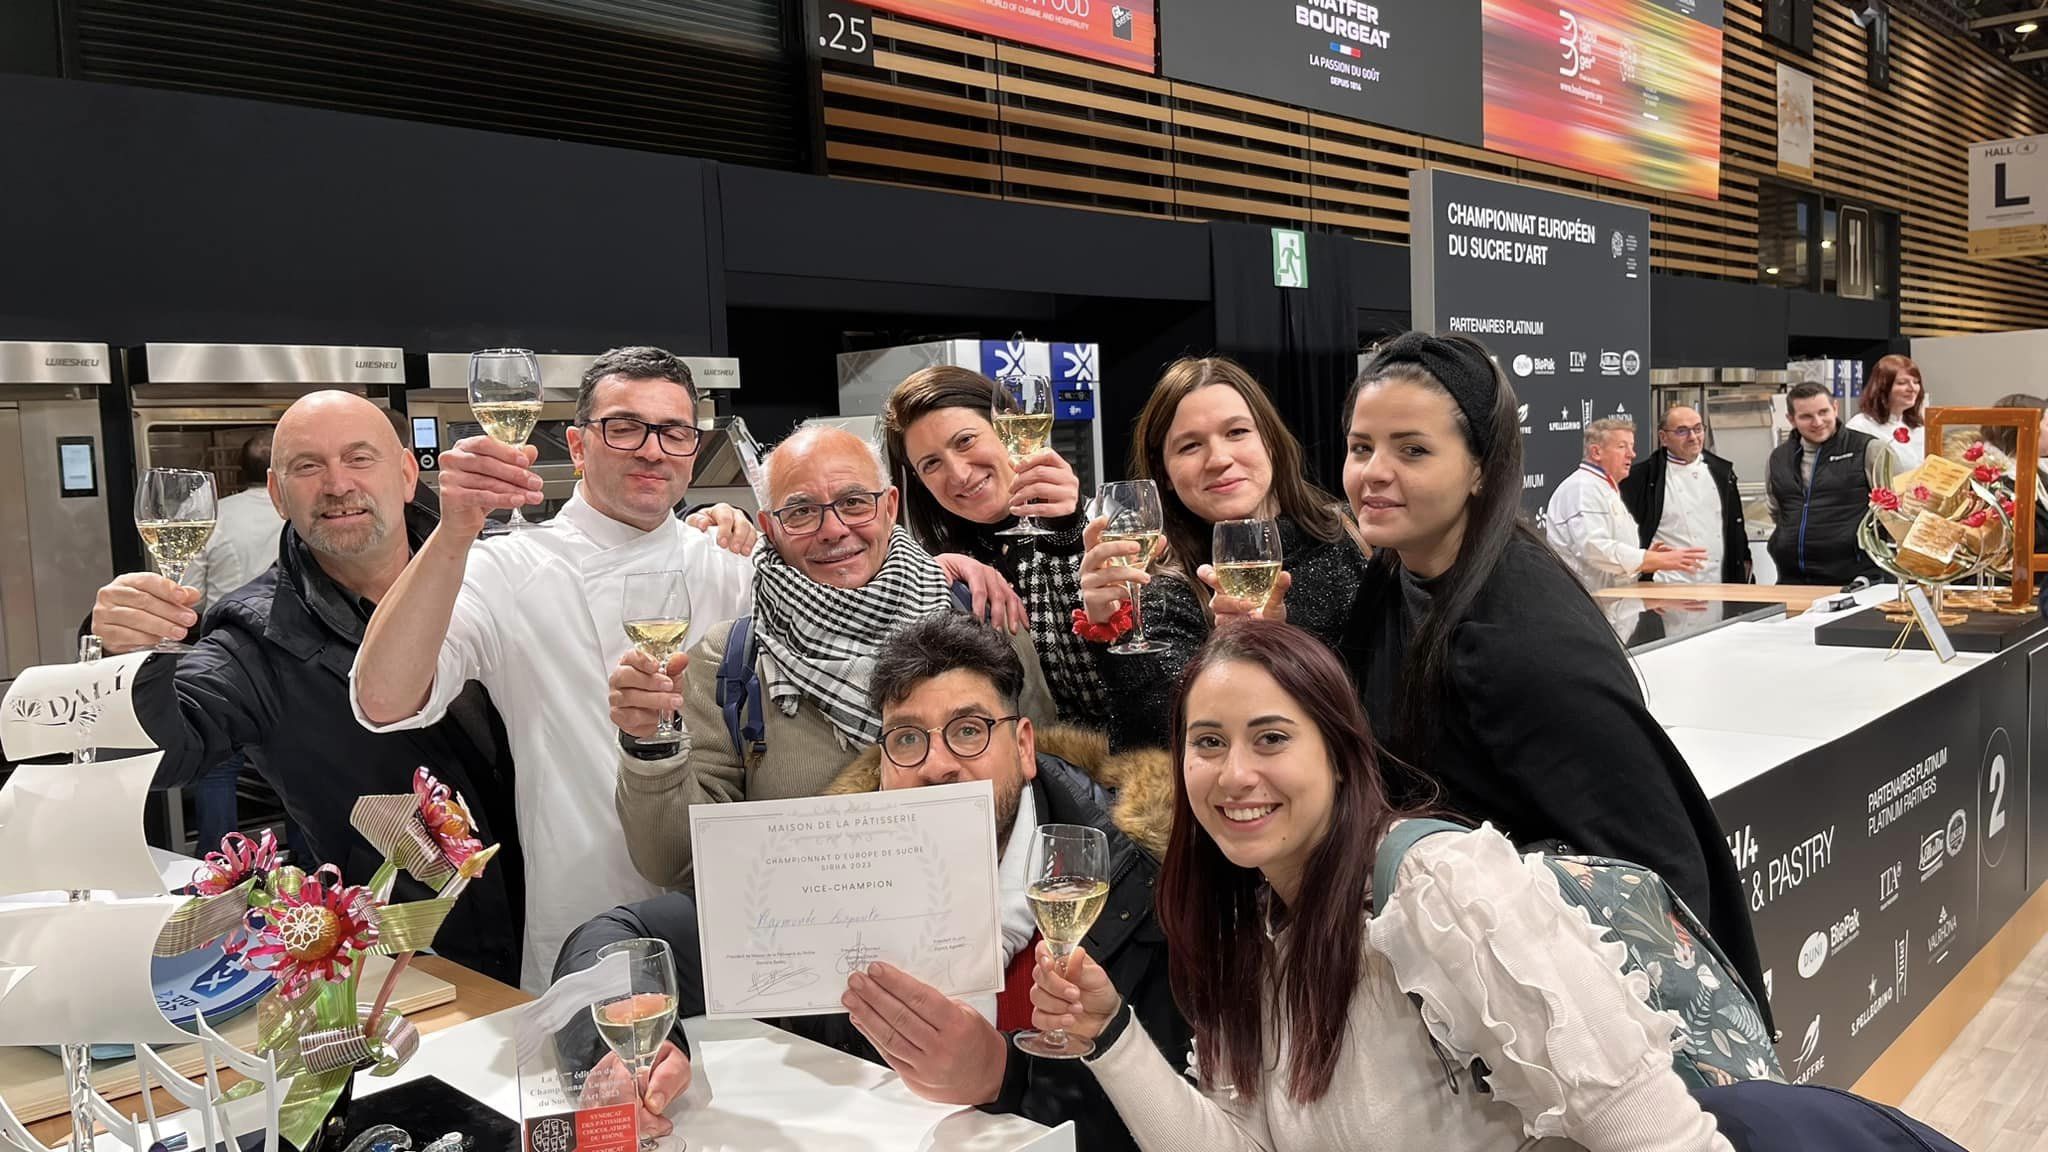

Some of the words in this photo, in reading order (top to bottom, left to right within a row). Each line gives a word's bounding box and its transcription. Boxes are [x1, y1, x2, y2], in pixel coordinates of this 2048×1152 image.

[1296, 5, 1390, 49] BOURGEAT
[1310, 54, 1319, 67] LA
[1320, 57, 1350, 75] PASSION
[1351, 65, 1361, 77] DU
[1362, 67, 1380, 82] GOÛT
[1330, 76, 1350, 88] DEPUIS
[1985, 146, 2013, 158] HALL
[1995, 163, 2030, 208] L
[1448, 202, 1536, 234] CHAMPIONNAT
[1538, 218, 1596, 244] EUROPÉEN
[1449, 234, 1467, 256] DU
[1470, 237, 1513, 262] SUCRE
[1515, 243, 1548, 266] D'ART
[1450, 317, 1505, 334] PARTENAIRES
[1506, 320, 1544, 335] PLATINUM
[45, 357, 99, 367] WIESHEU
[355, 360, 398, 369] WIESHEU
[1523, 473, 1544, 489] MIUM
[1868, 772, 1915, 813] PARTENAIRES
[1916, 746, 1948, 783] PLATINUM
[1868, 798, 1903, 837] PLATINUM
[1903, 775, 1937, 813] PARTNERS
[1988, 754, 2006, 839] 2
[768, 822, 813, 833] MAISON
[818, 820, 831, 830] DE
[836, 819, 850, 828] LA
[855, 812, 917, 827] PÂTISSERIE
[766, 853, 831, 865] CHAMPIONNAT
[882, 849, 892, 857] DE
[896, 846, 924, 856] SUCRE
[1751, 870, 1765, 911] &
[1768, 825, 1834, 901] PASTRY
[801, 879, 893, 894] VICE-CHAMPION
[1830, 907, 1860, 948] BioPak
[1803, 942, 1823, 968] DUNI
[1851, 986, 1893, 1037] S.PELLEGRINO
